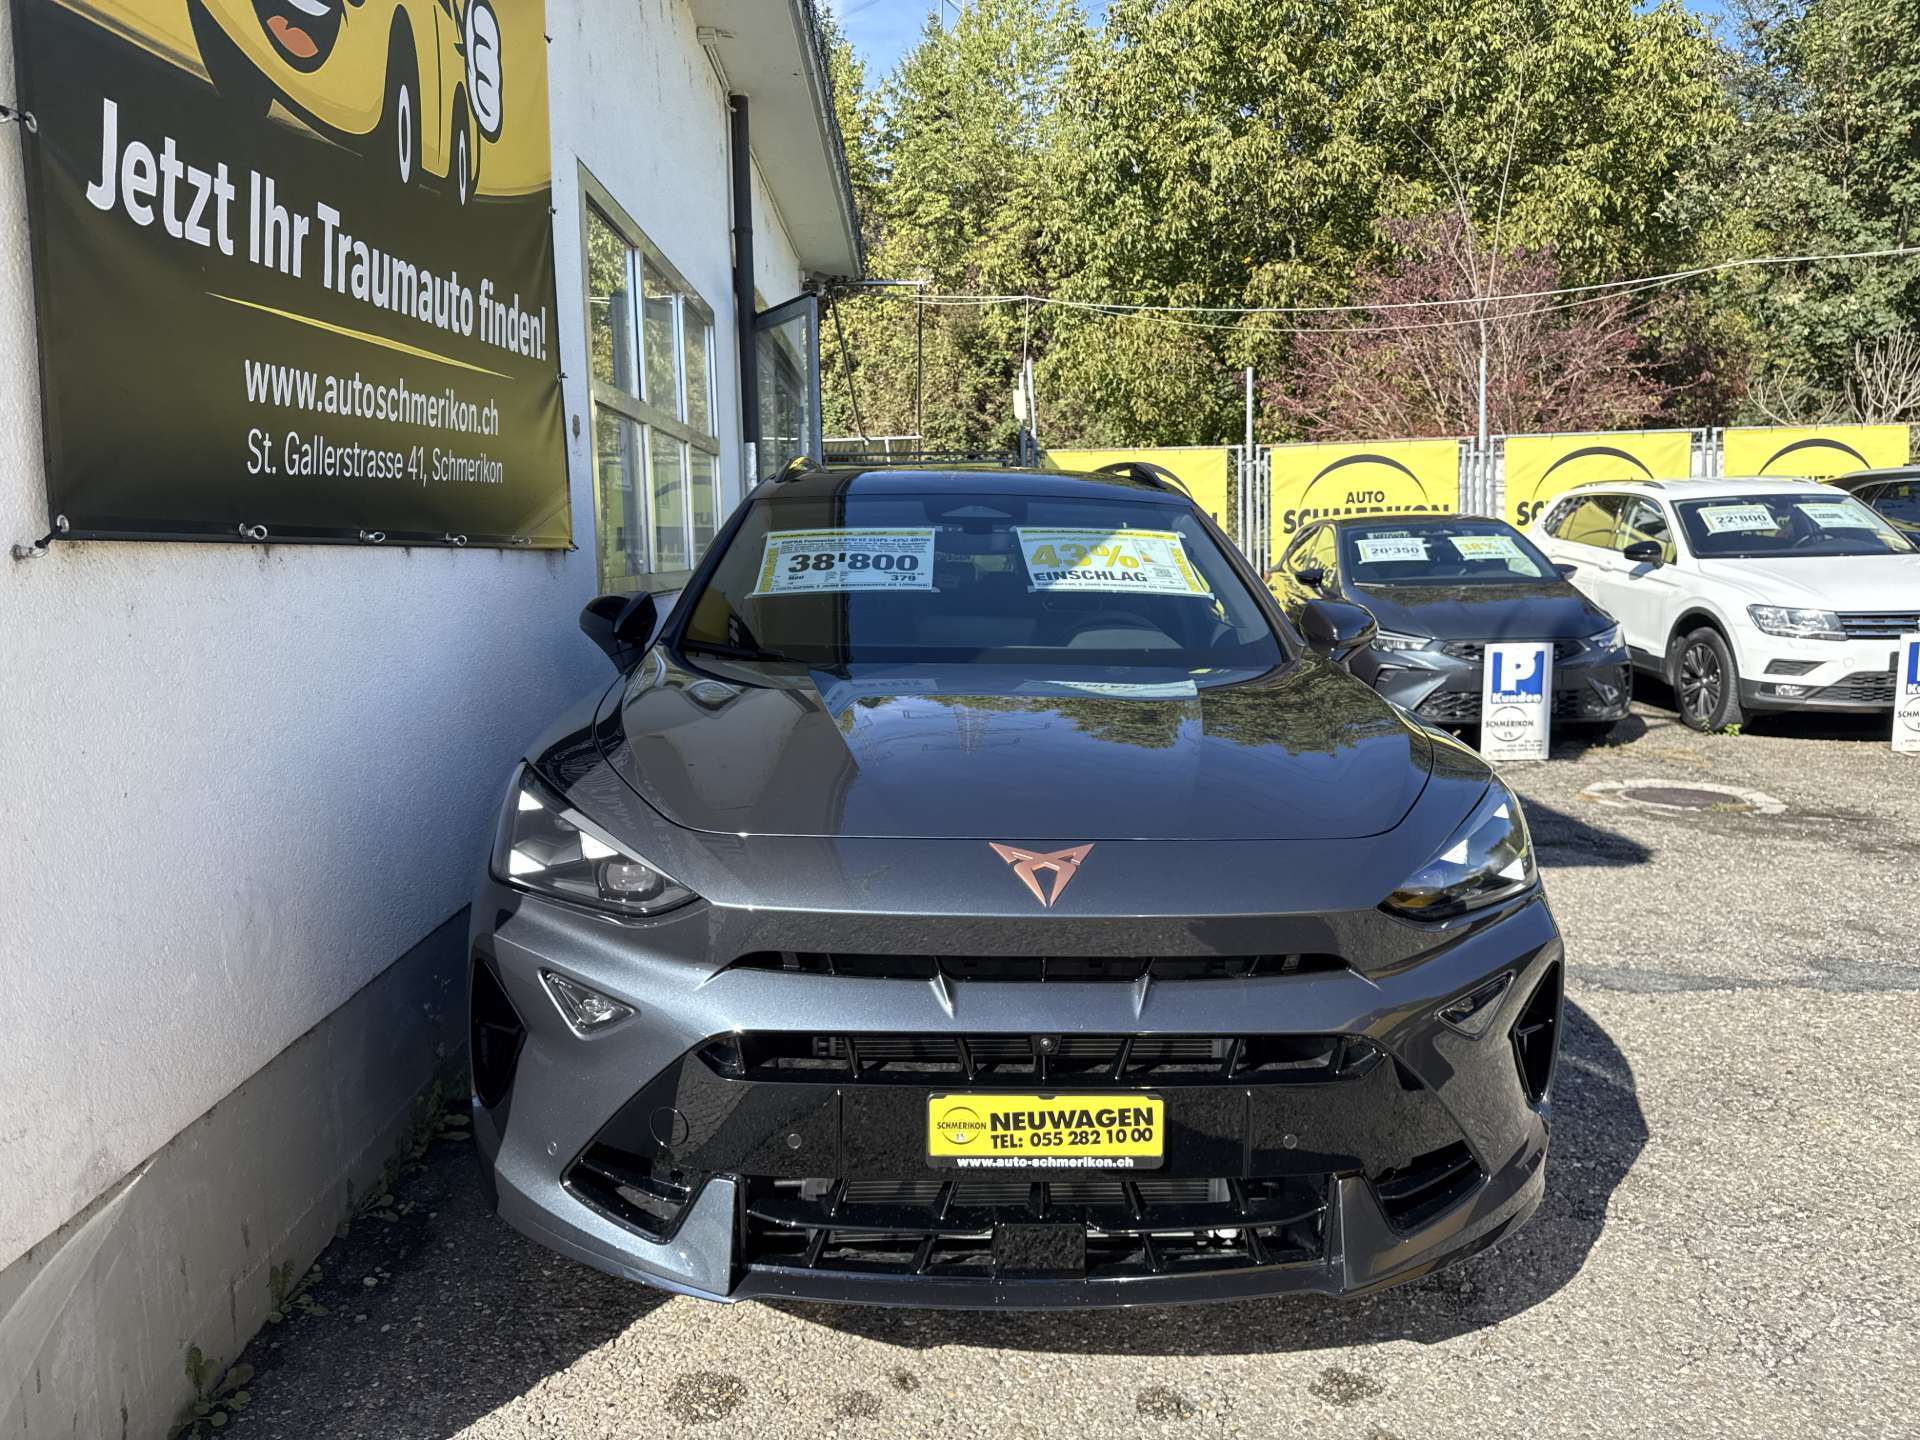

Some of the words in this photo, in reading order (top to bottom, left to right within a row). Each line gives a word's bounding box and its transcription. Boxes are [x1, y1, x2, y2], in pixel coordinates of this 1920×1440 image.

[86, 97, 235, 256] Jetzt
[250, 169, 309, 278] Ihr
[317, 201, 473, 337] Traumauto
[479, 278, 546, 361] finden!
[245, 359, 499, 436] www.autoschmerikon.ch
[247, 428, 277, 475] St.
[284, 431, 403, 478] Gallerstrasse
[407, 445, 427, 487] 41,
[432, 447, 503, 484] Schmerikon
[1345, 491, 1385, 504] AUTO
[788, 553, 919, 573] 38'800
[1030, 543, 1140, 569] 43%
[891, 574, 916, 582] 379
[1033, 570, 1147, 582] EINSCHLAG
[936, 1121, 987, 1130] SCHMERIKON
[990, 1107, 1154, 1132] NEUWAGEN
[991, 1133, 1024, 1149] TEL:
[1030, 1131, 1063, 1147] 055
[1068, 1129, 1101, 1145] 282
[1107, 1128, 1127, 1144] 10
[1130, 1127, 1153, 1142] 00
[956, 1156, 1134, 1167] www.auto-schmerikon.ch
